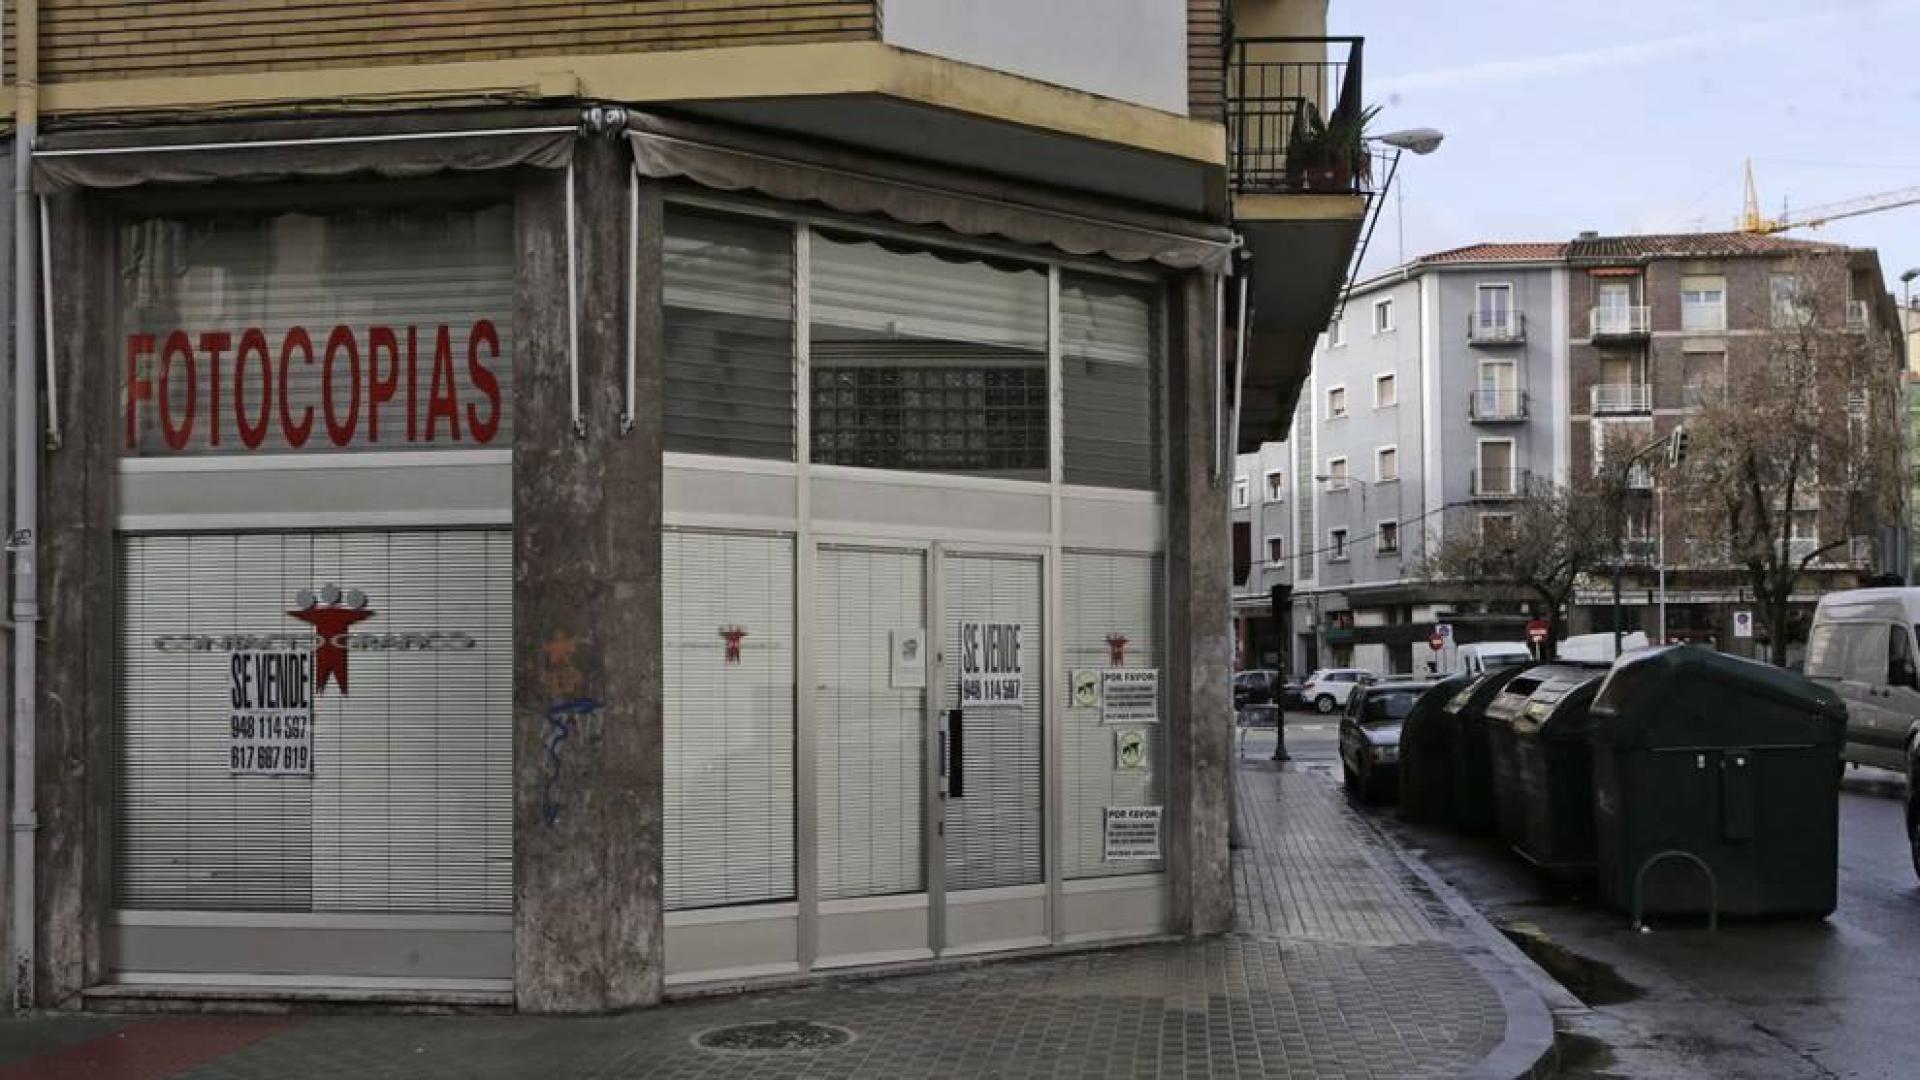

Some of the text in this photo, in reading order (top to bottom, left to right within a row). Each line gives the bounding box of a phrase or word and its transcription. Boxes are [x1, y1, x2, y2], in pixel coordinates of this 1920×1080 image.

[126, 319, 502, 450] FOTOCOPIAS
[964, 624, 1020, 673] SE VENDE
[232, 653, 308, 709] SE VENDE
[984, 679, 1002, 700] 114
[232, 715, 255, 740] 948
[259, 715, 282, 740] 114
[232, 745, 255, 769] 617
[284, 745, 308, 769] 619
